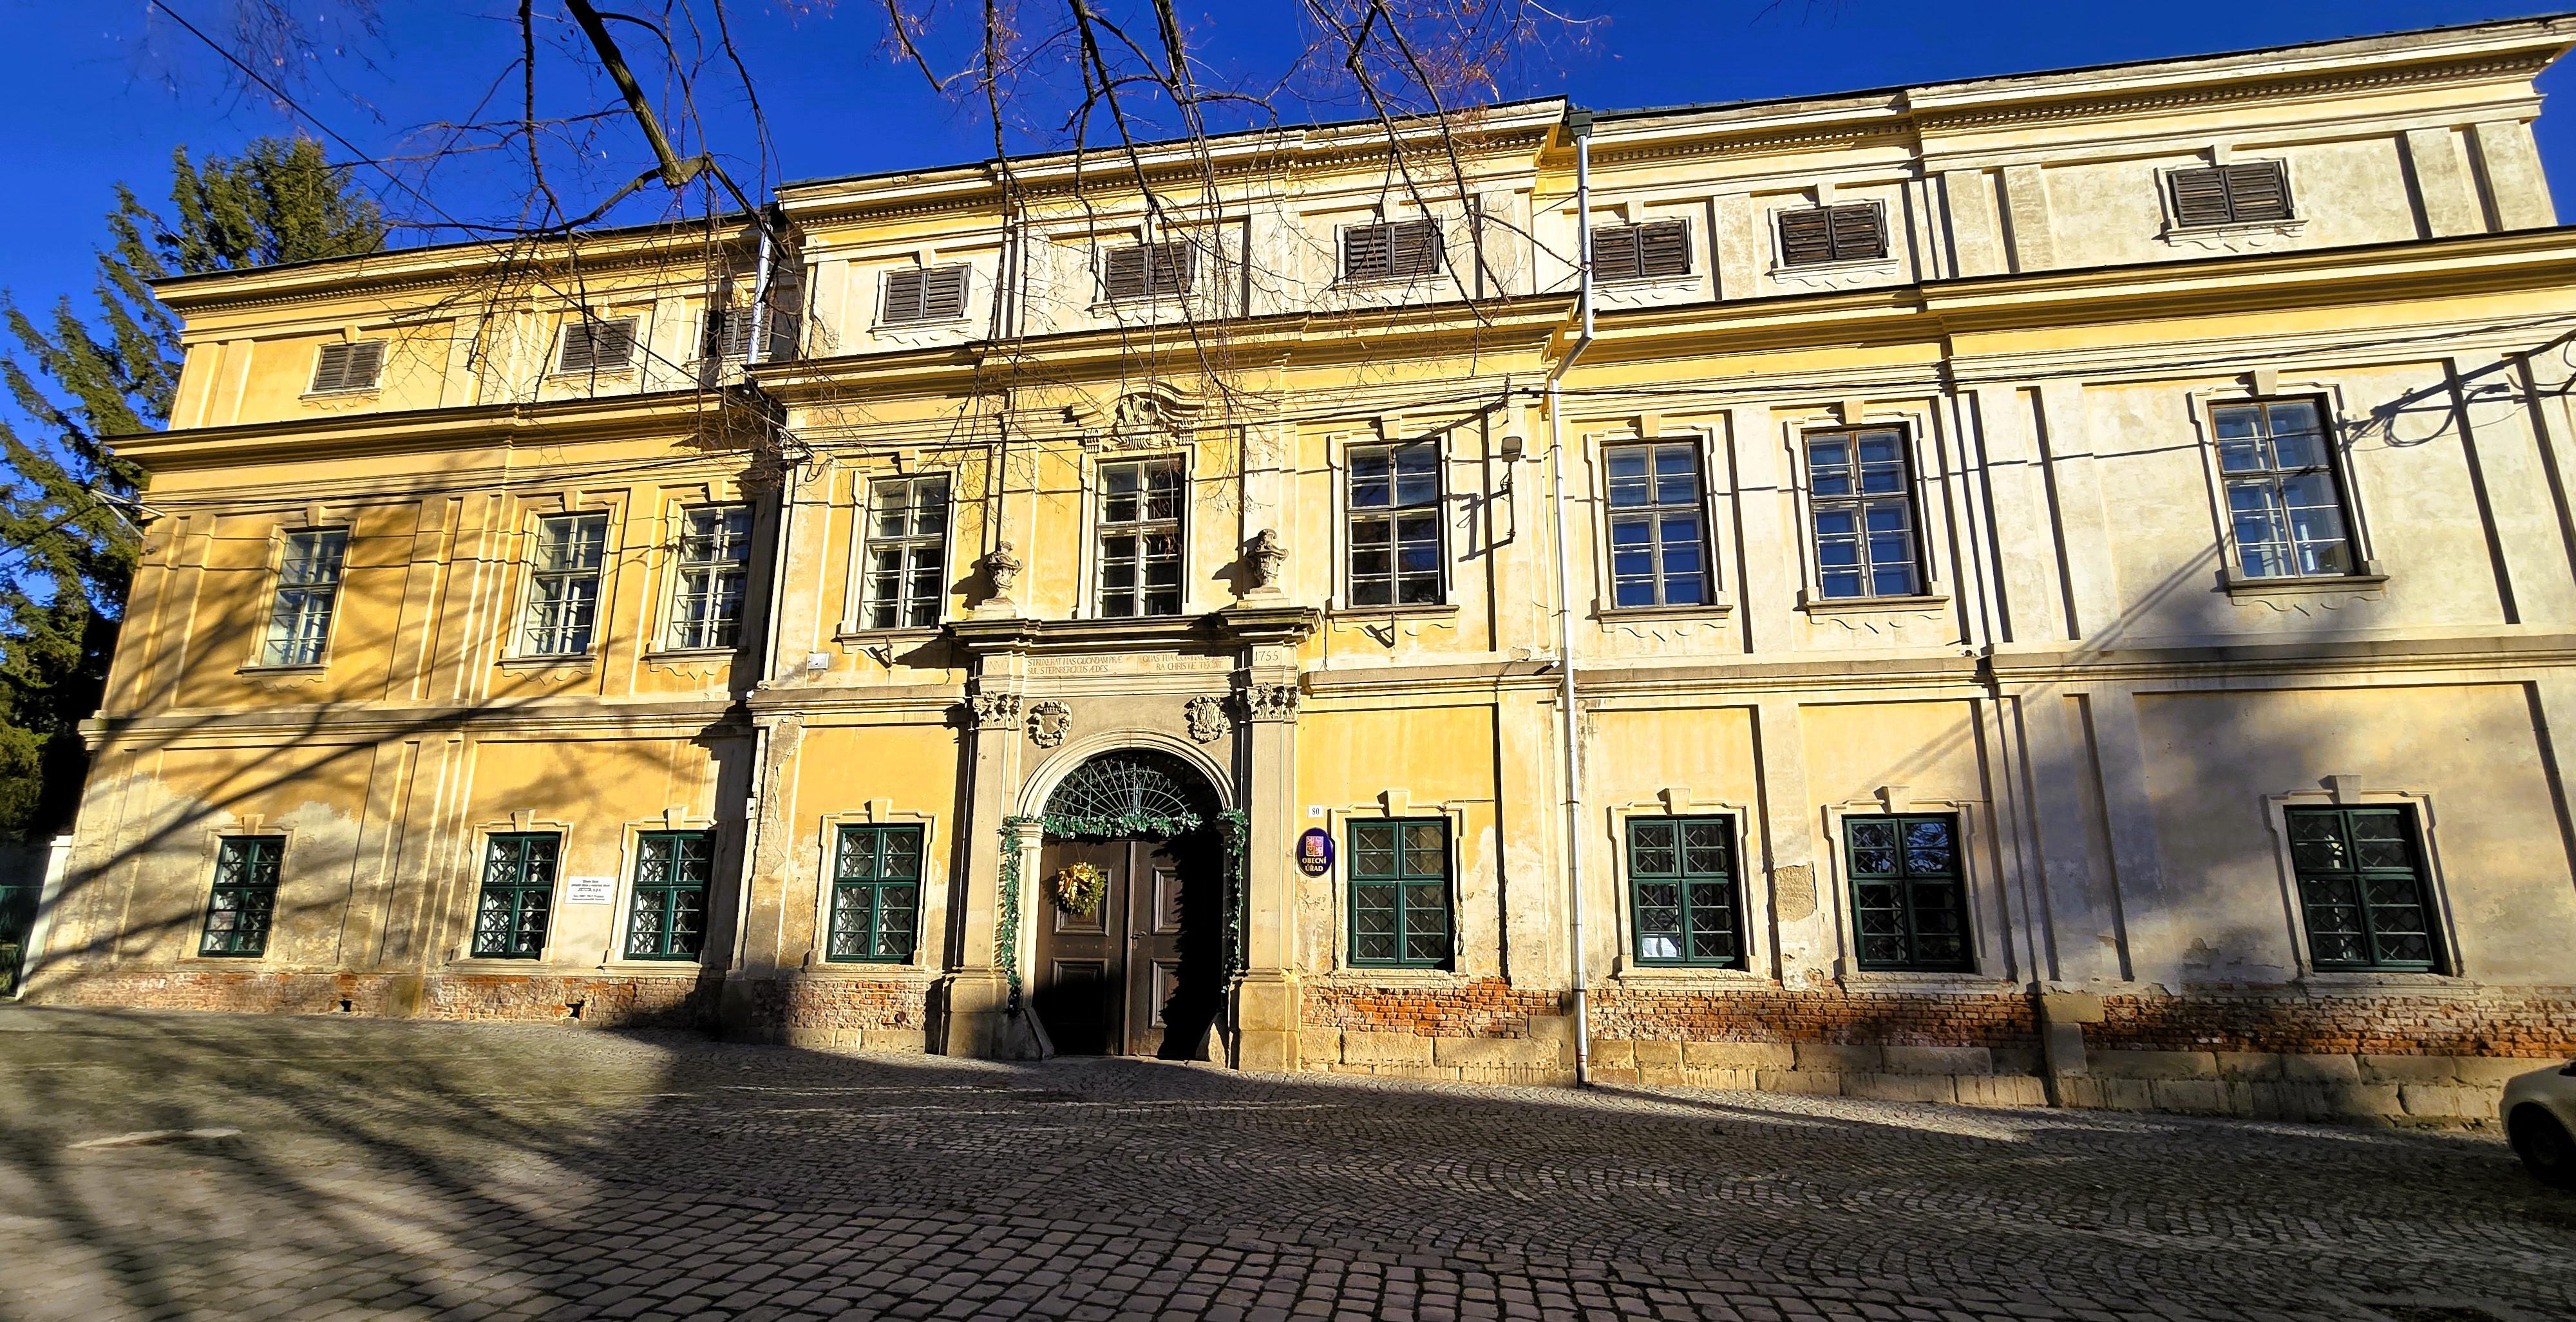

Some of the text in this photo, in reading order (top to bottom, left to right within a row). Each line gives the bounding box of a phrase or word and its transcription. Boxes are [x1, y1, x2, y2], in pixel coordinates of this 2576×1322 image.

[1077, 656, 1108, 665] QUONDAM
[1142, 654, 1160, 663] QUAS
[1254, 650, 1278, 662] 1755
[1168, 661, 1196, 670] CHRISTE
